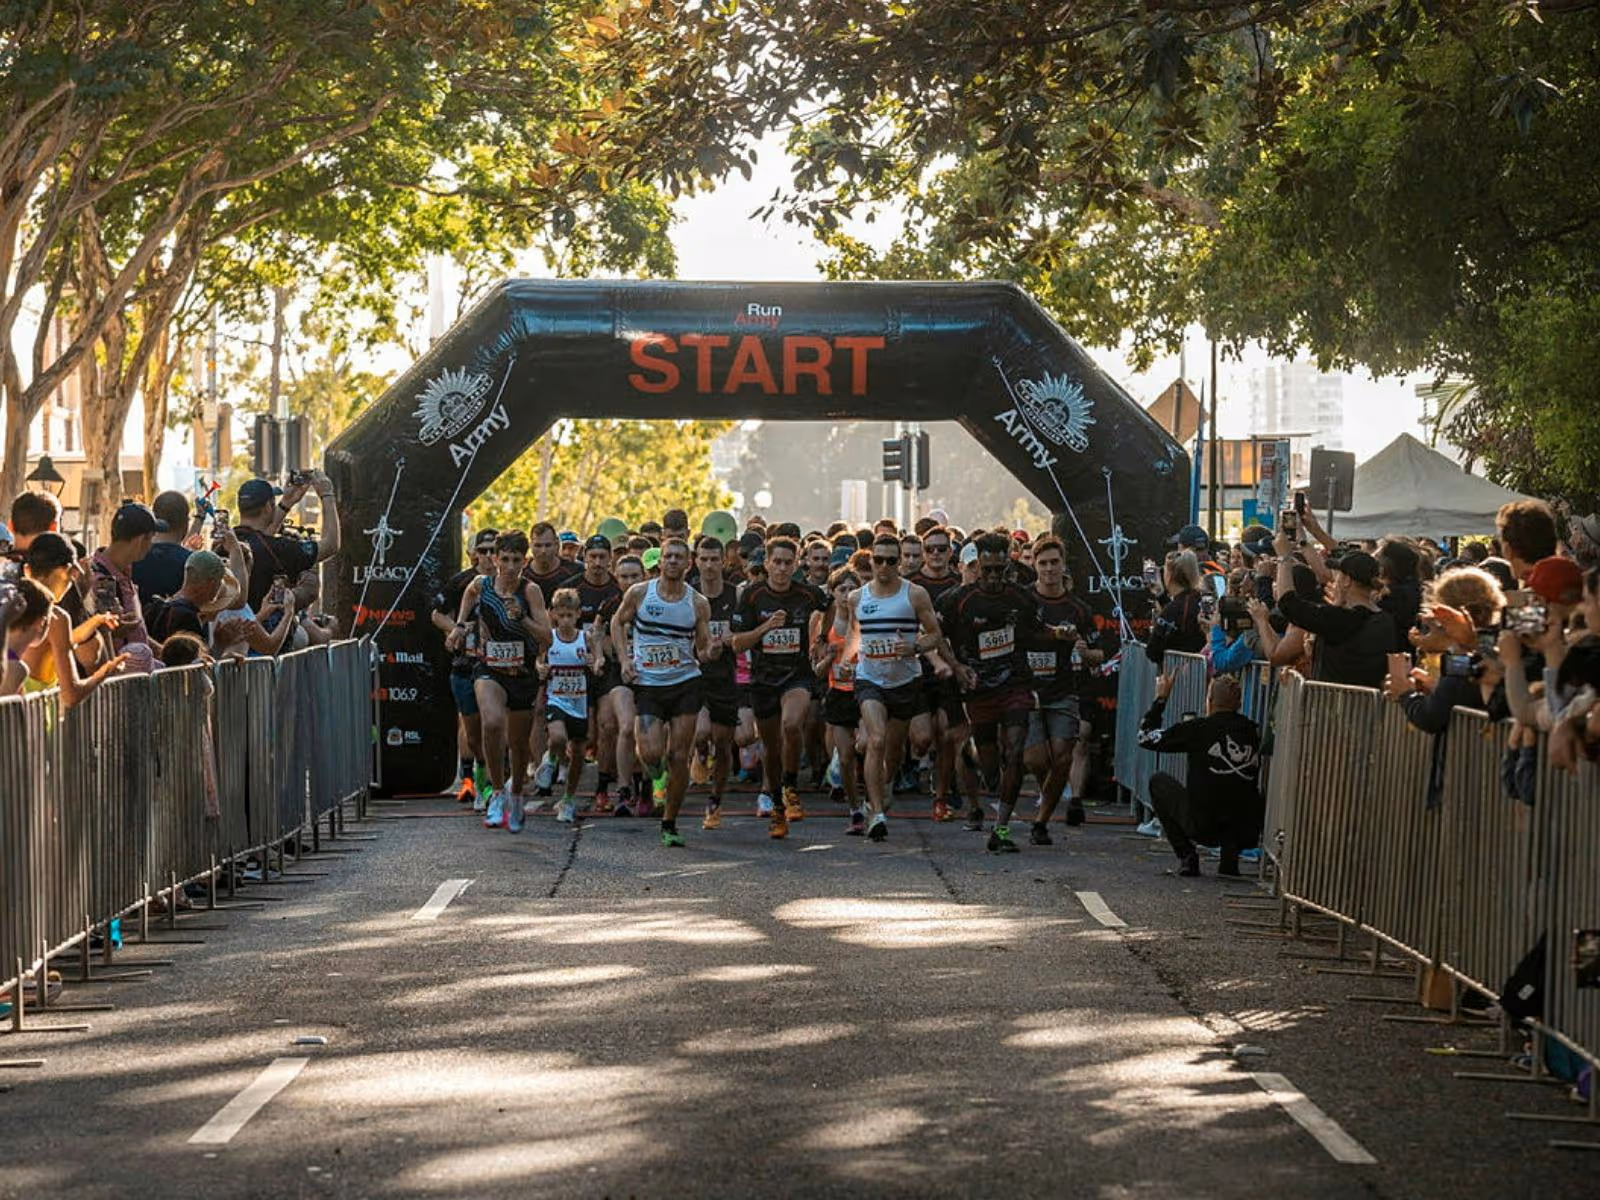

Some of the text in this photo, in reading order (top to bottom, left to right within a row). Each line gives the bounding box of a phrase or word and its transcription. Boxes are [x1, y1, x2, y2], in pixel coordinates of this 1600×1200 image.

[734, 312, 779, 330] Army
[747, 302, 782, 316] Run
[627, 332, 886, 396] START
[449, 404, 510, 468] Army
[994, 409, 1058, 469] Army
[353, 566, 412, 584] LEGACY
